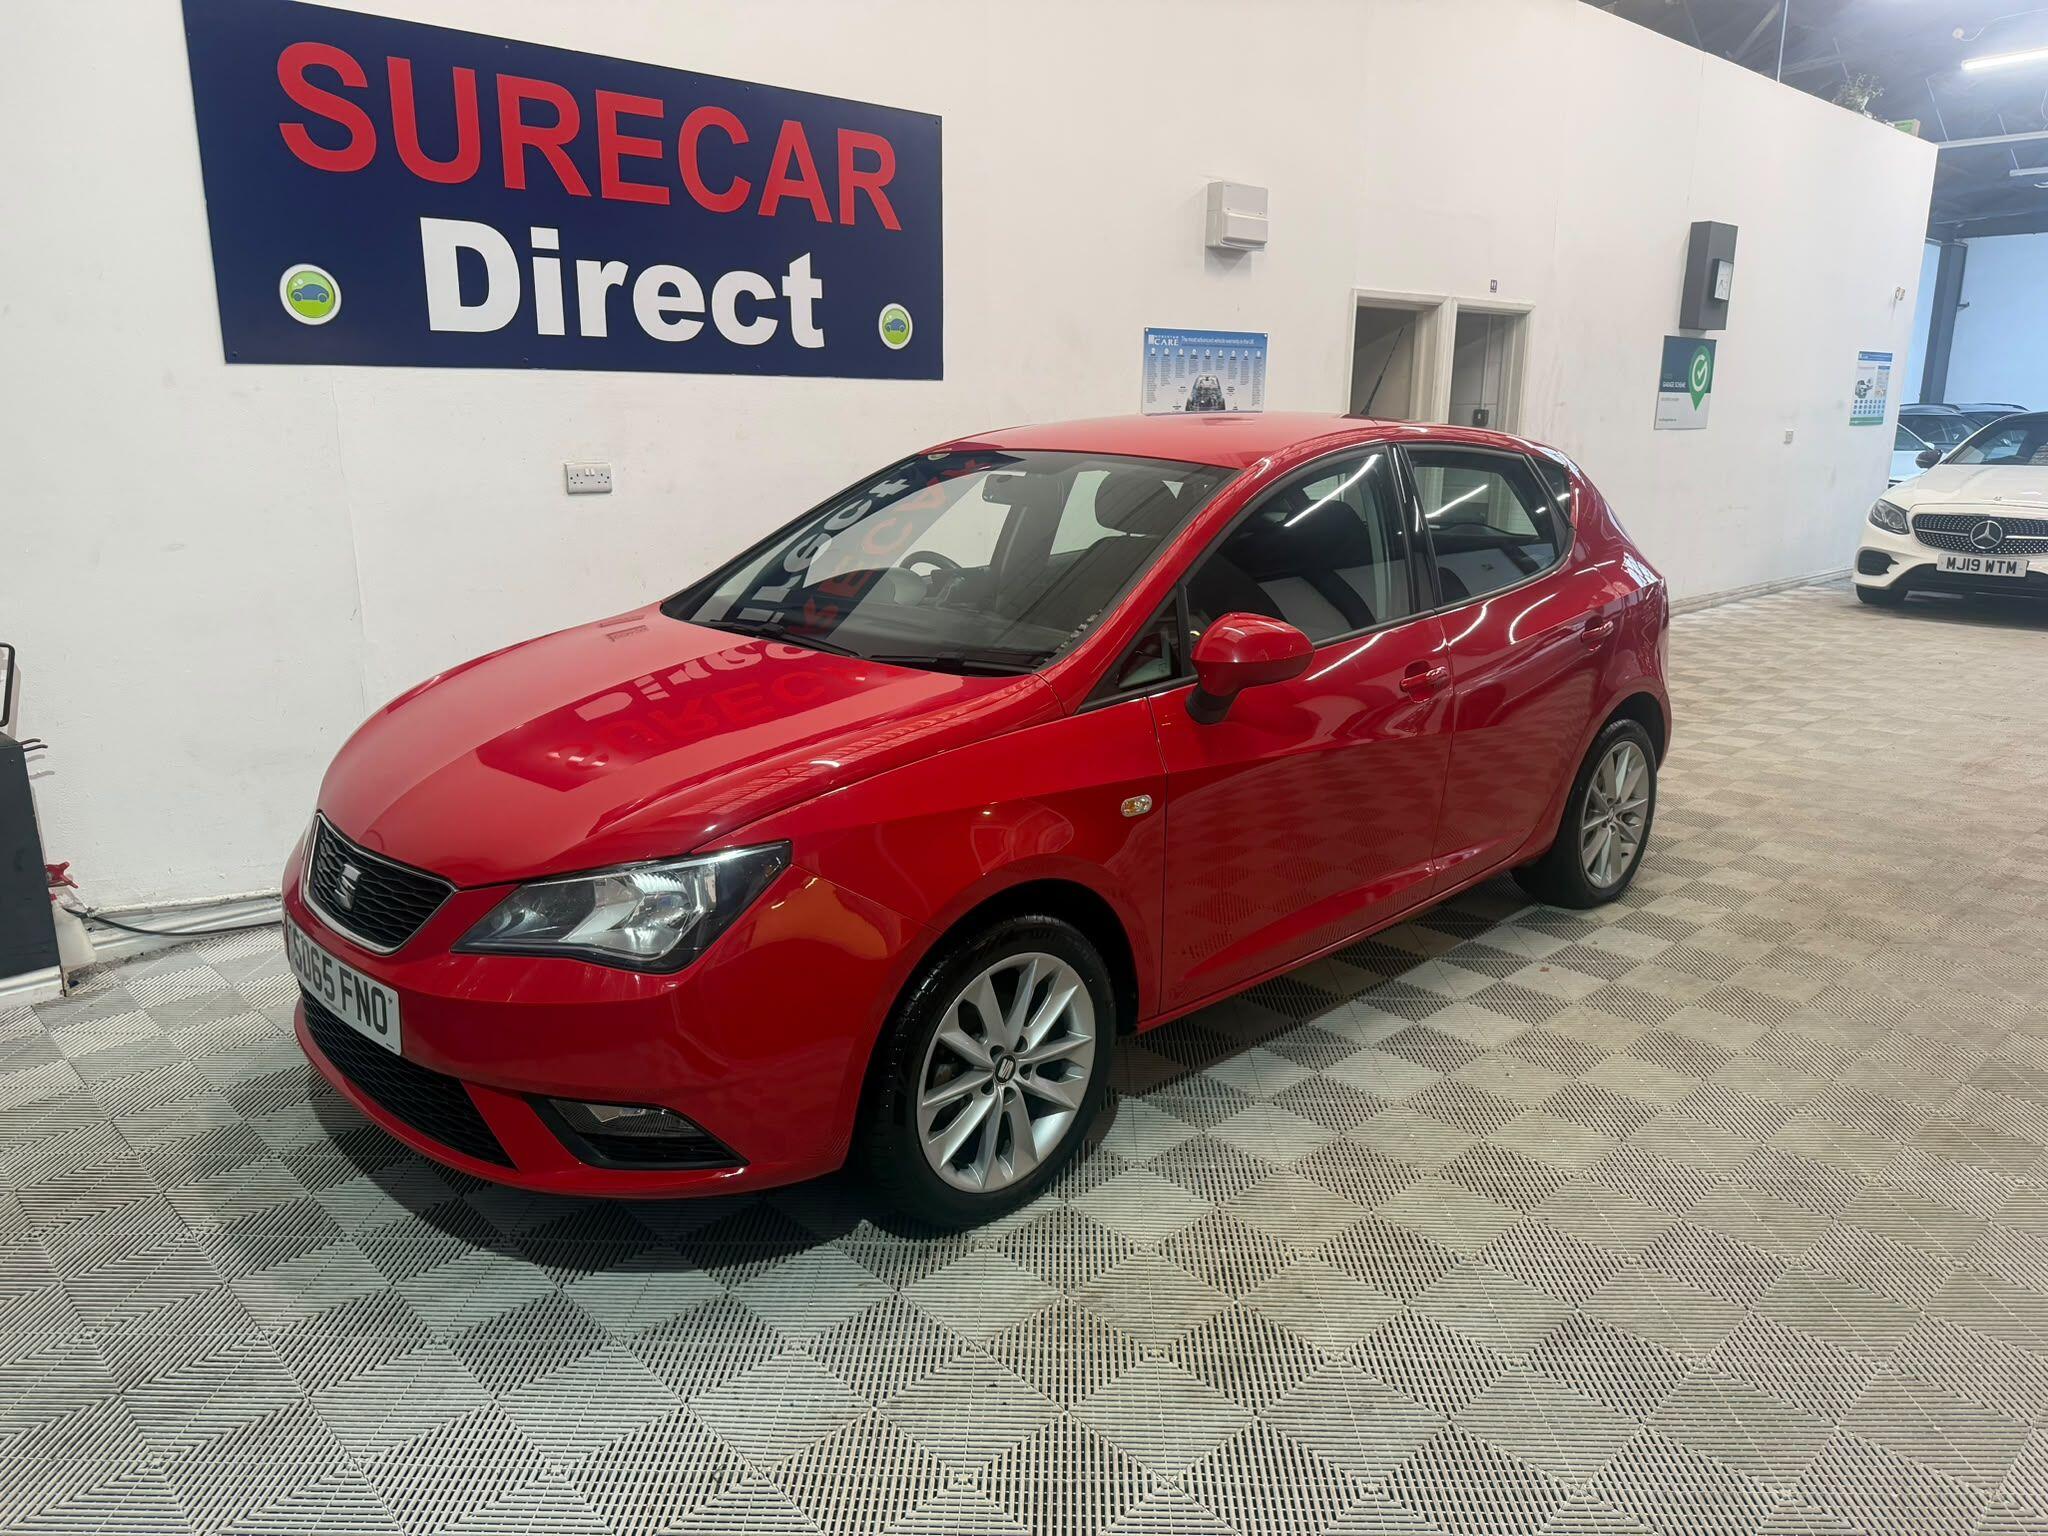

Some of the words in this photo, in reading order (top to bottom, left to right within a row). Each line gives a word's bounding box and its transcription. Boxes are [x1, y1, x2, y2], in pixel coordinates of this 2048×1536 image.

[277, 42, 902, 231] SURECAR
[419, 217, 825, 349] Direct
[1154, 338, 1179, 346] CARE
[1945, 556, 1981, 572] MJ19
[1984, 559, 2018, 574] WTM
[338, 965, 388, 1036] FNO
